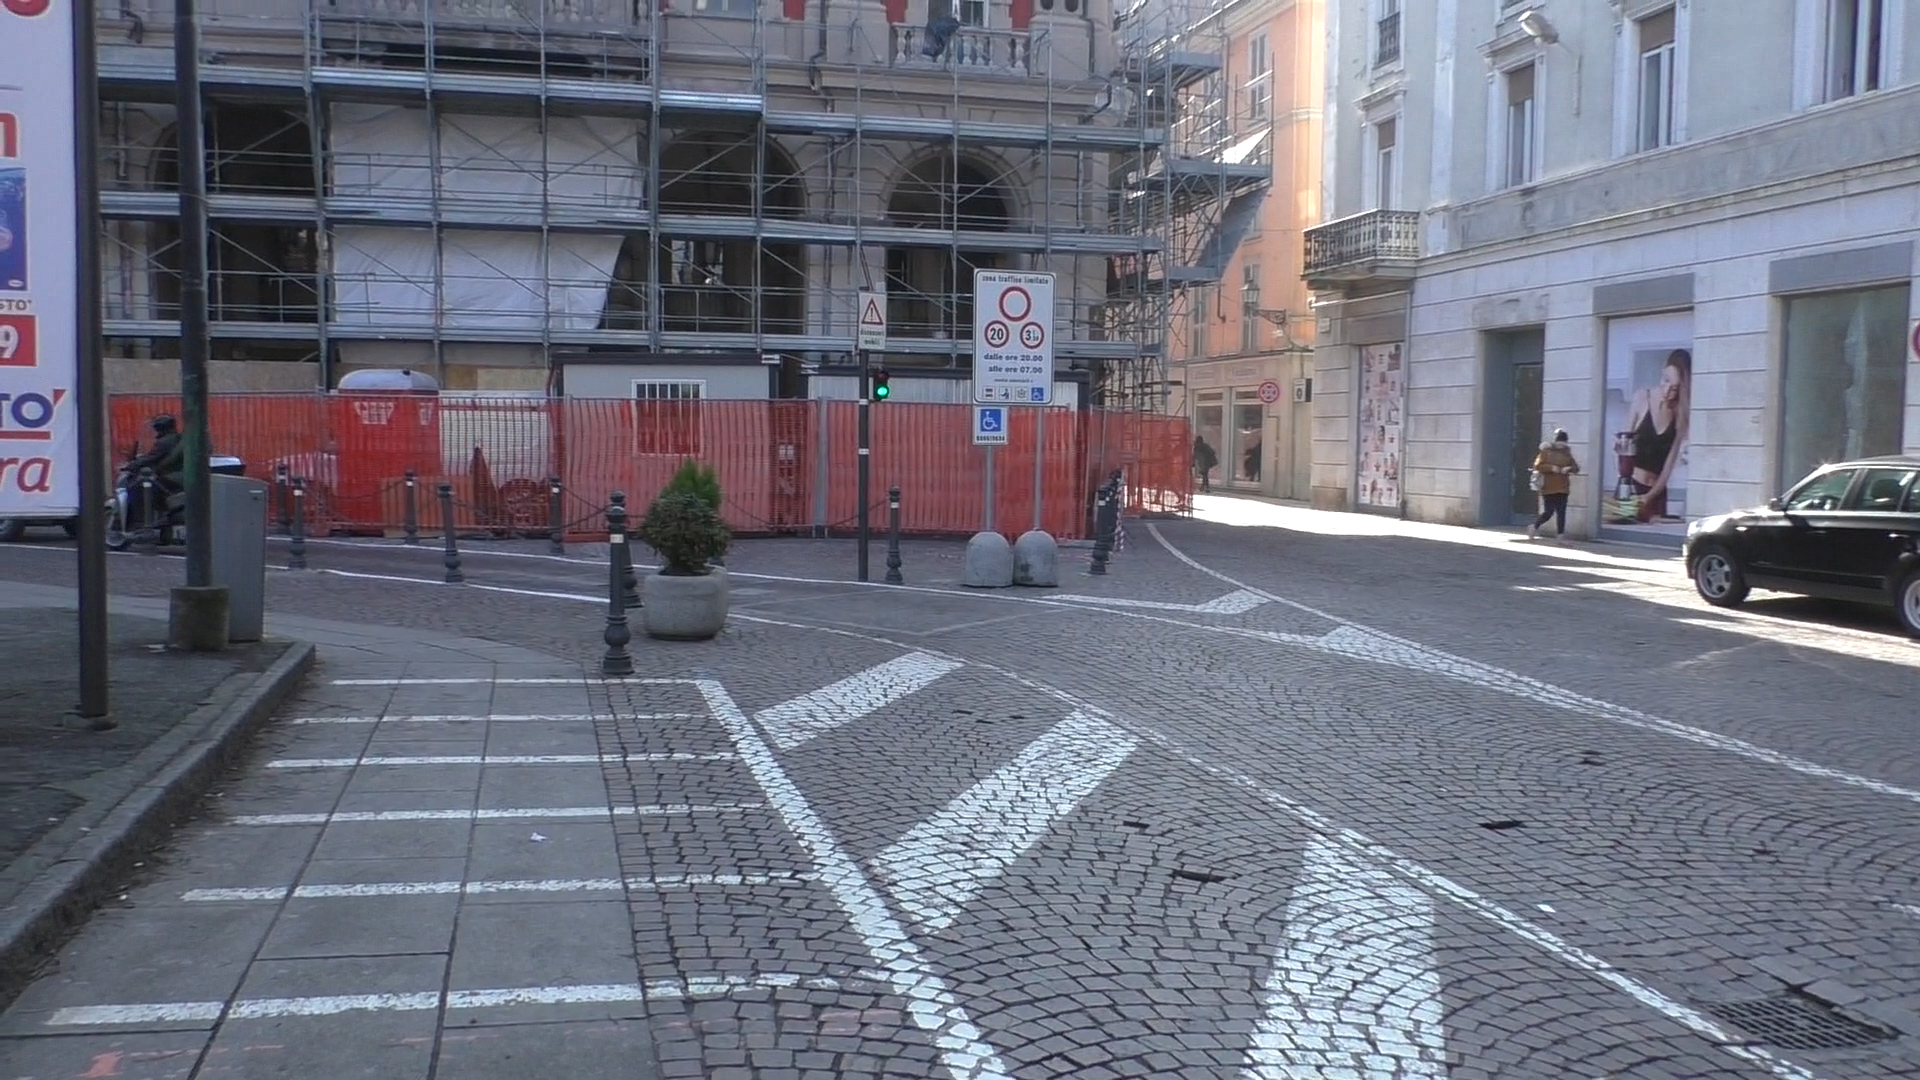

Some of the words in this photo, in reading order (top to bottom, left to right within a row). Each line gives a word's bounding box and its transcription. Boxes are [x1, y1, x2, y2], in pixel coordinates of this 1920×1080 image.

[998, 275, 1022, 283] traffico
[1024, 276, 1048, 285] limitato
[990, 328, 1004, 341] 20
[984, 353, 1003, 361] dalle
[1020, 354, 1043, 362] 20.00
[988, 365, 1003, 373] alle
[1020, 366, 1043, 374] 07.00
